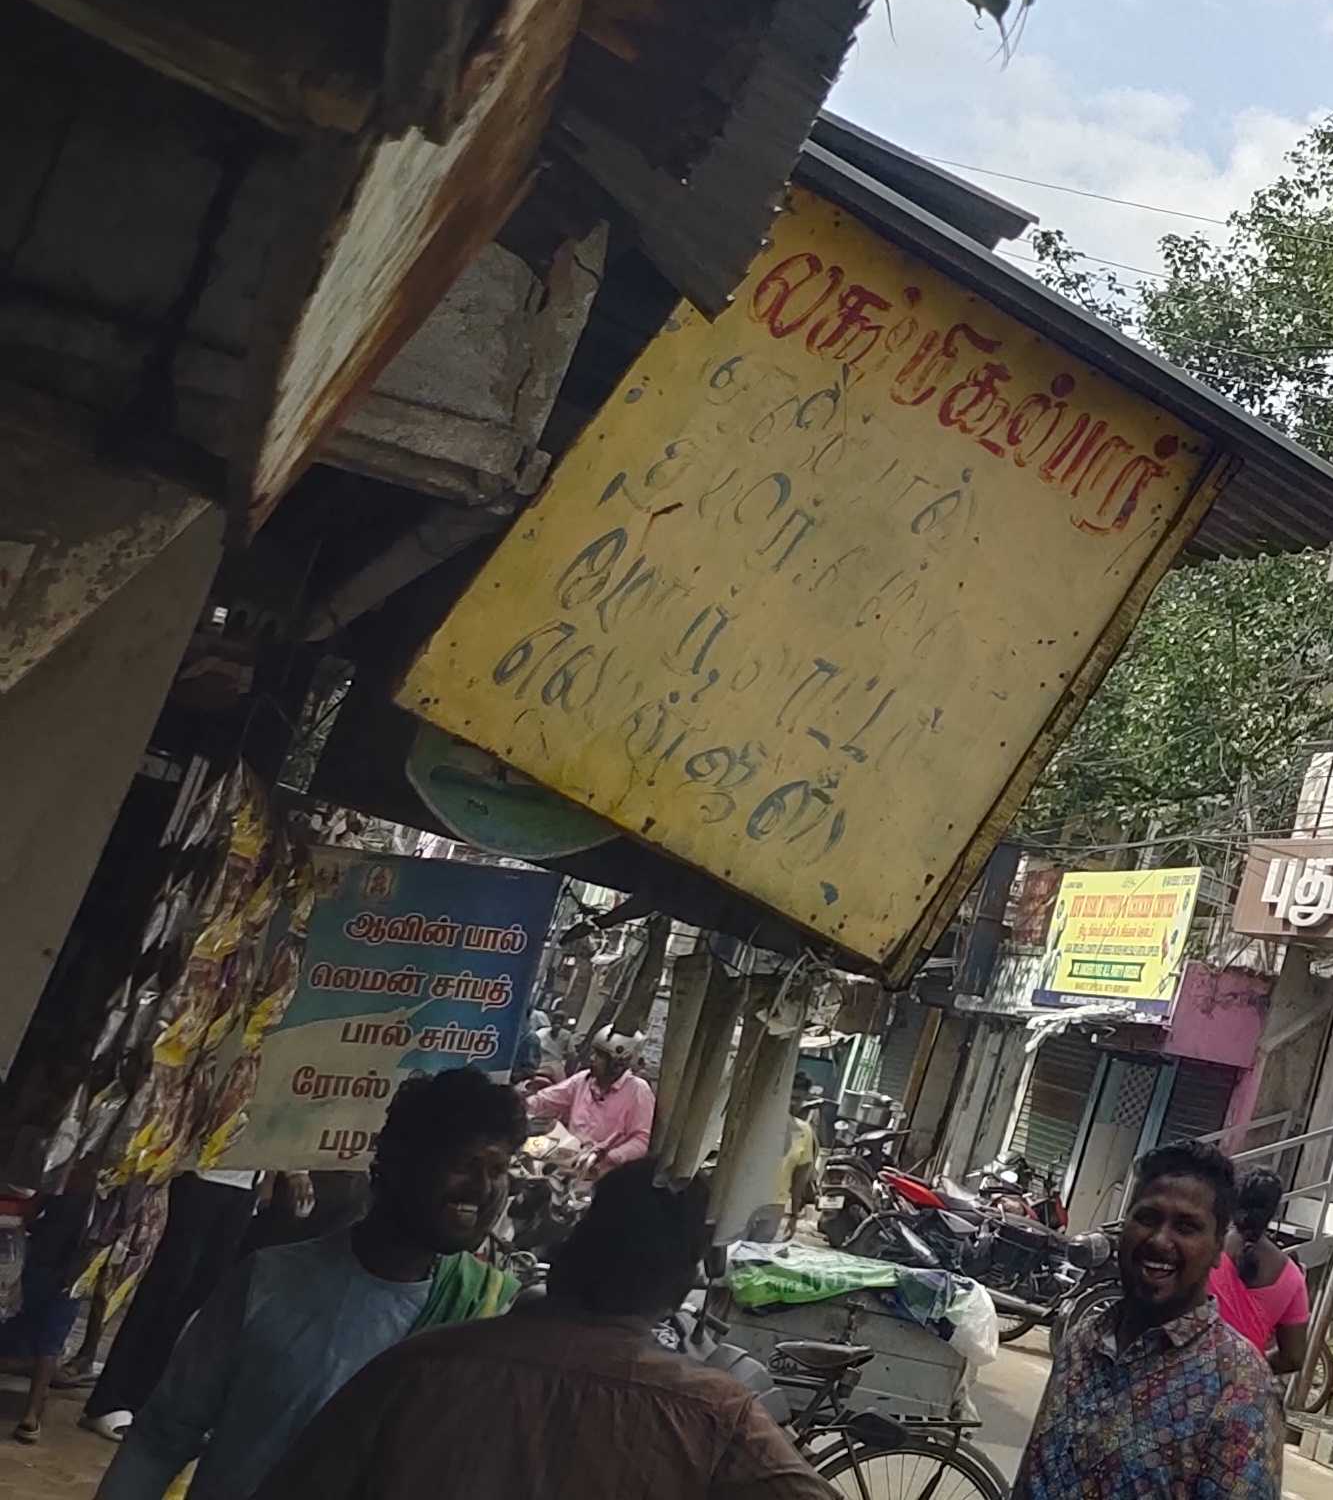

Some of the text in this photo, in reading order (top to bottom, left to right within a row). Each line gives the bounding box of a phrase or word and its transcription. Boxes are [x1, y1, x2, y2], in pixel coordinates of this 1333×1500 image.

[345, 911, 528, 954] ஆவின் பால்
[310, 962, 513, 1013] லெமன் சர்பத்
[340, 1016, 501, 1064] பால் சர்பத்
[292, 1065, 391, 1100] ரோஸ்
